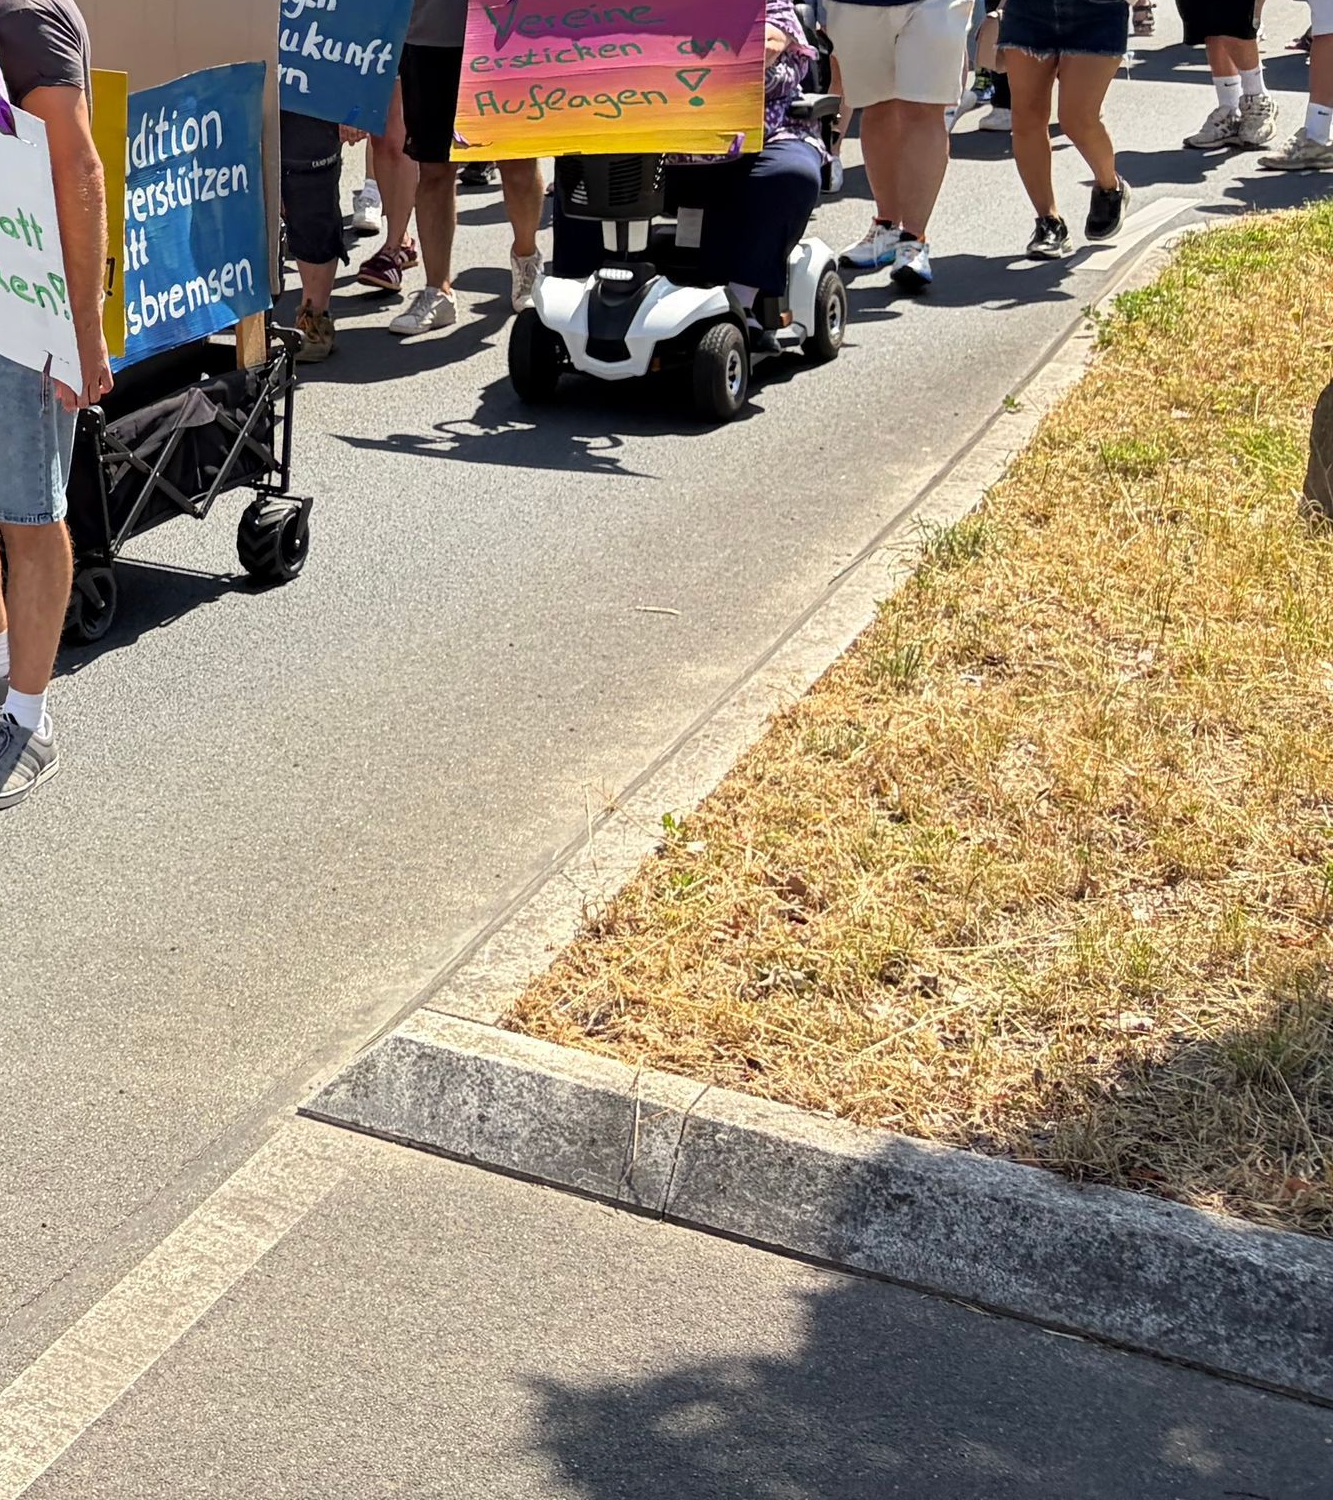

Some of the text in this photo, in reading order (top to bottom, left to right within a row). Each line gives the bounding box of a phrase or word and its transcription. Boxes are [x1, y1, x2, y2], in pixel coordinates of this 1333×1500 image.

[484, 0, 666, 40] Vereine
[470, 38, 730, 73] ersticken an
[124, 257, 254, 340] sbremsen
